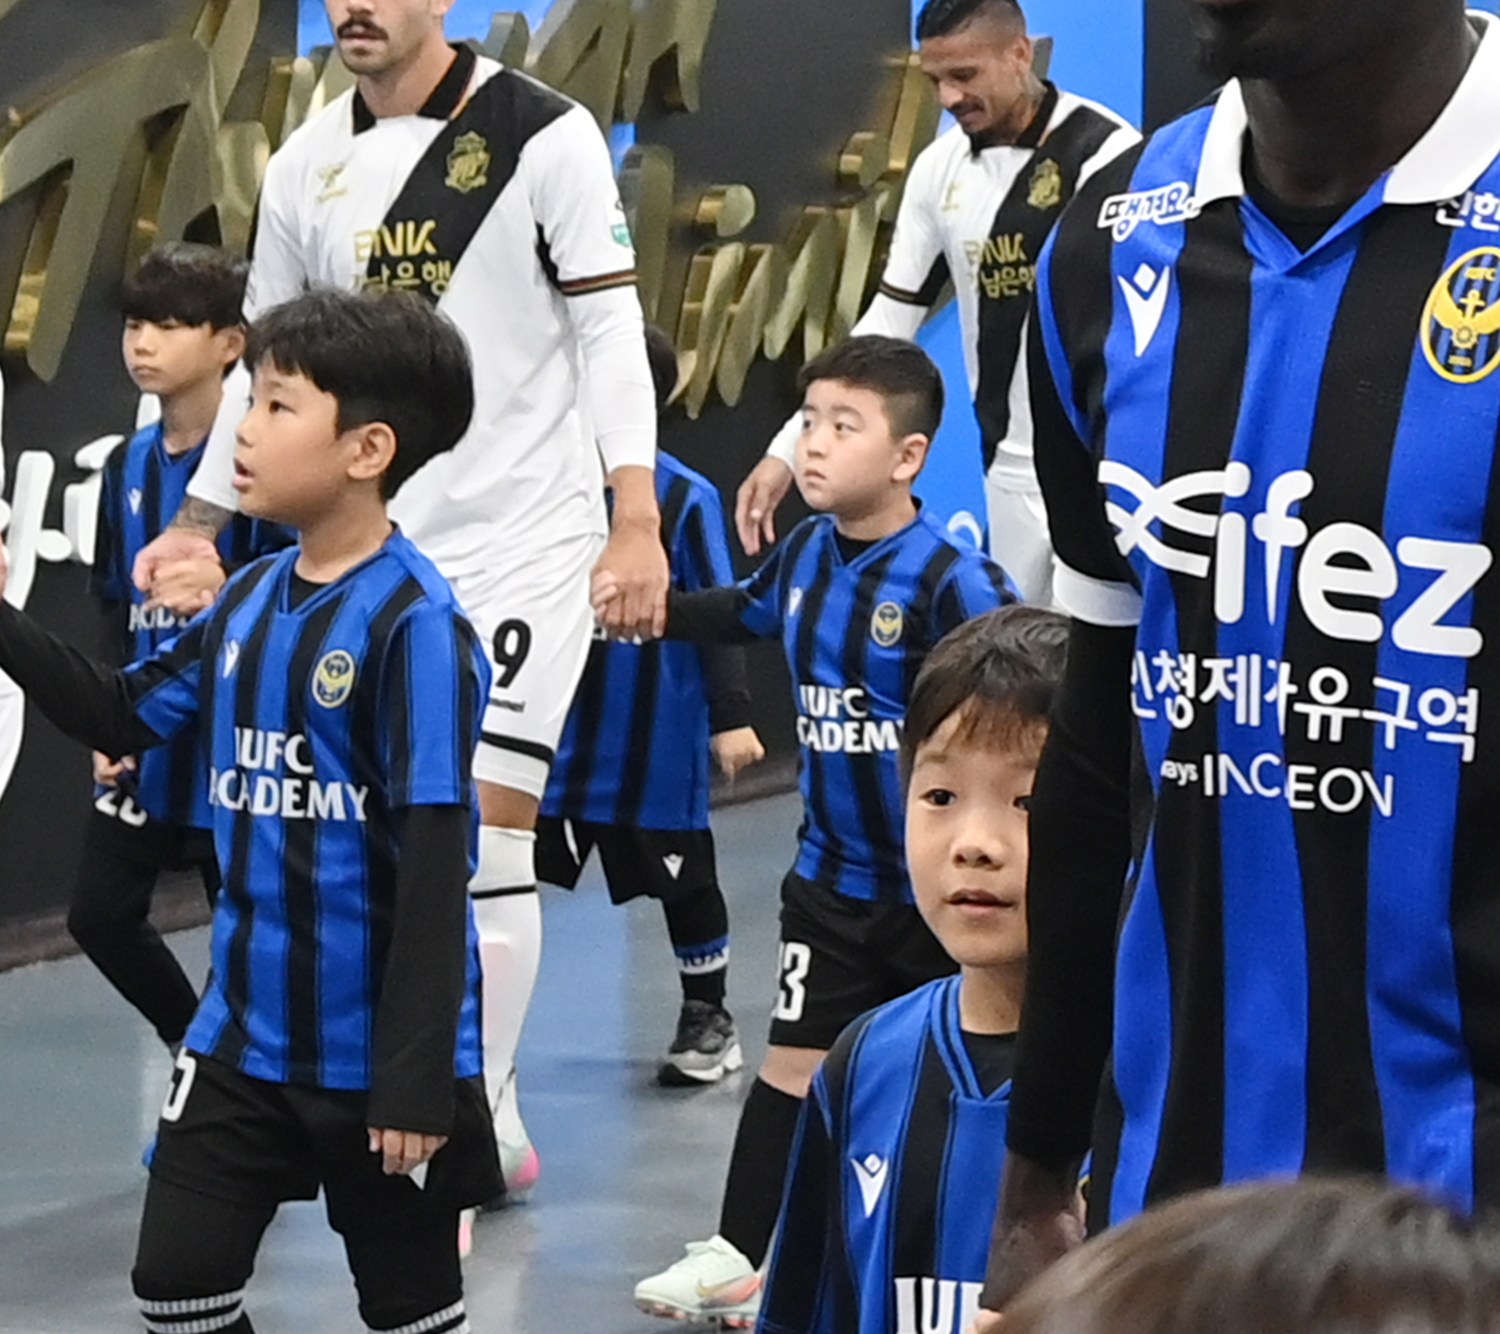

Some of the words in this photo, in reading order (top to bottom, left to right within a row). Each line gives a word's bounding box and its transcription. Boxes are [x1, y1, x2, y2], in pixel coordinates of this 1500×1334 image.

[354, 219, 438, 263] BNK
[963, 232, 1028, 265] BNK
[1213, 462, 1494, 659] ifez
[235, 726, 314, 774] IUFC
[797, 715, 905, 754] CADEM
[771, 940, 812, 1023] 3
